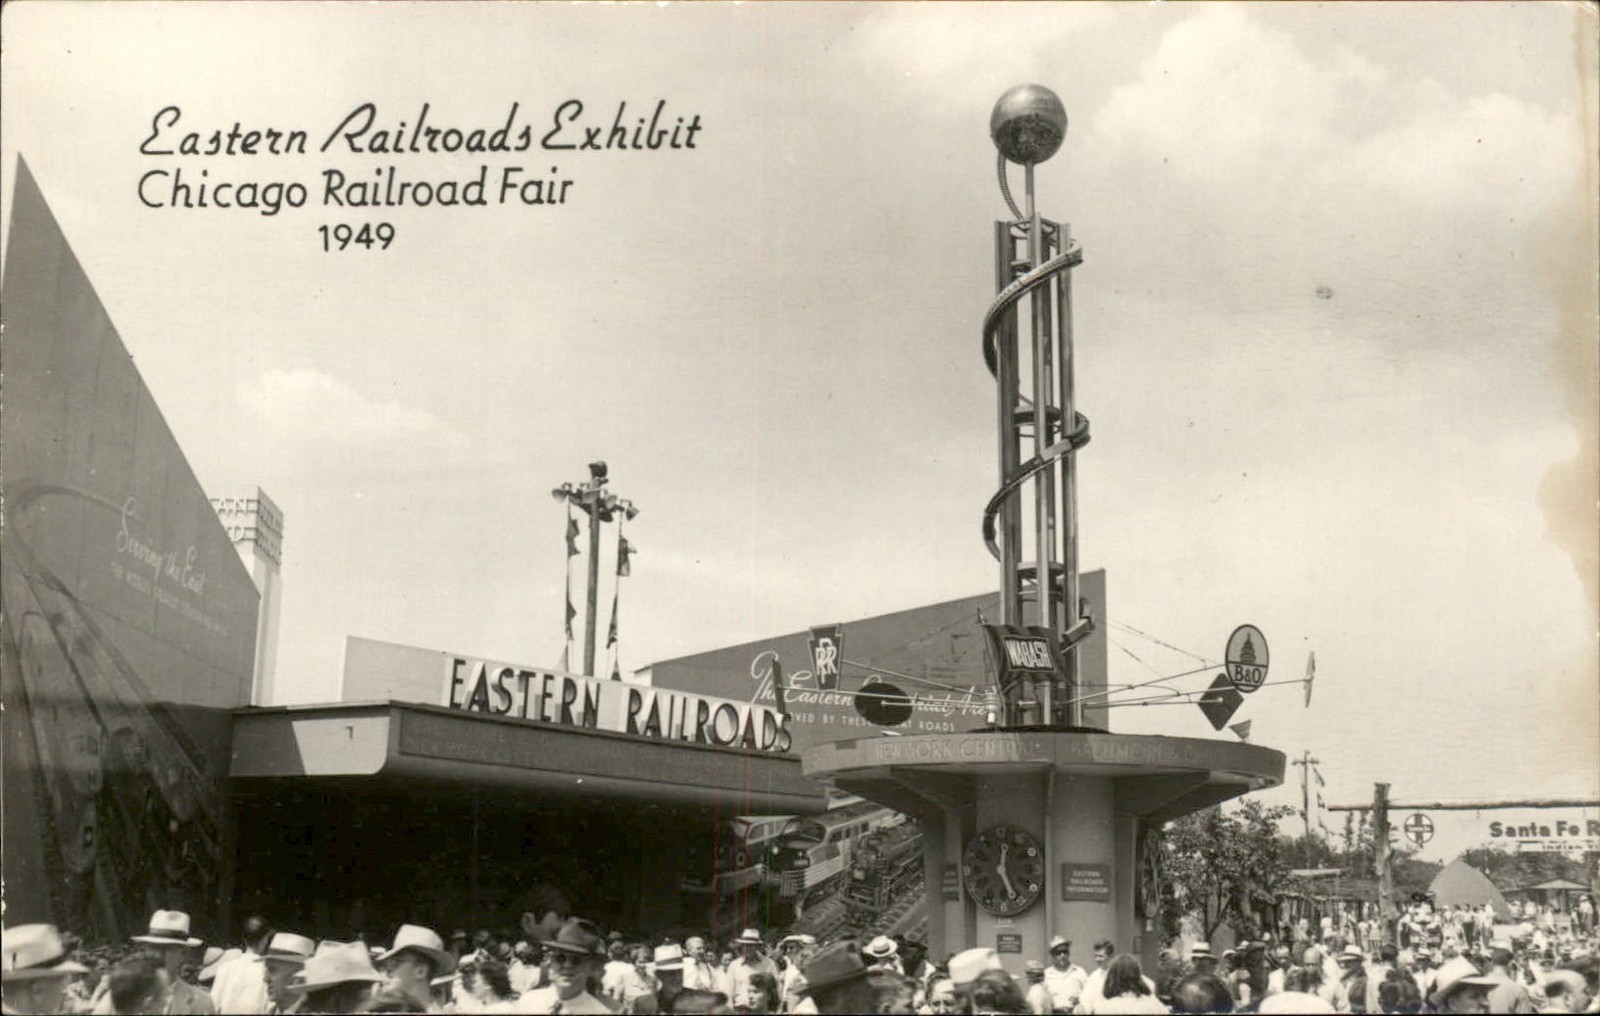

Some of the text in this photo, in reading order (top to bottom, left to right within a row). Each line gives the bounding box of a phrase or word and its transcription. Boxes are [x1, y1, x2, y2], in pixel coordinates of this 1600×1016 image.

[117, 497, 163, 581] Serving
[1005, 640, 1053, 669] WABASH
[1234, 664, 1262, 684] B&O
[784, 670, 853, 706] Eastern
[448, 657, 600, 728] EASTERN
[626, 687, 792, 753] RAILROADS
[823, 713, 836, 725] BY
[918, 721, 955, 735] ROADS
[873, 739, 1041, 764] NEW YORK CENTRAL
[1489, 821, 1550, 837] Santa
[1556, 820, 1580, 836] Fe
